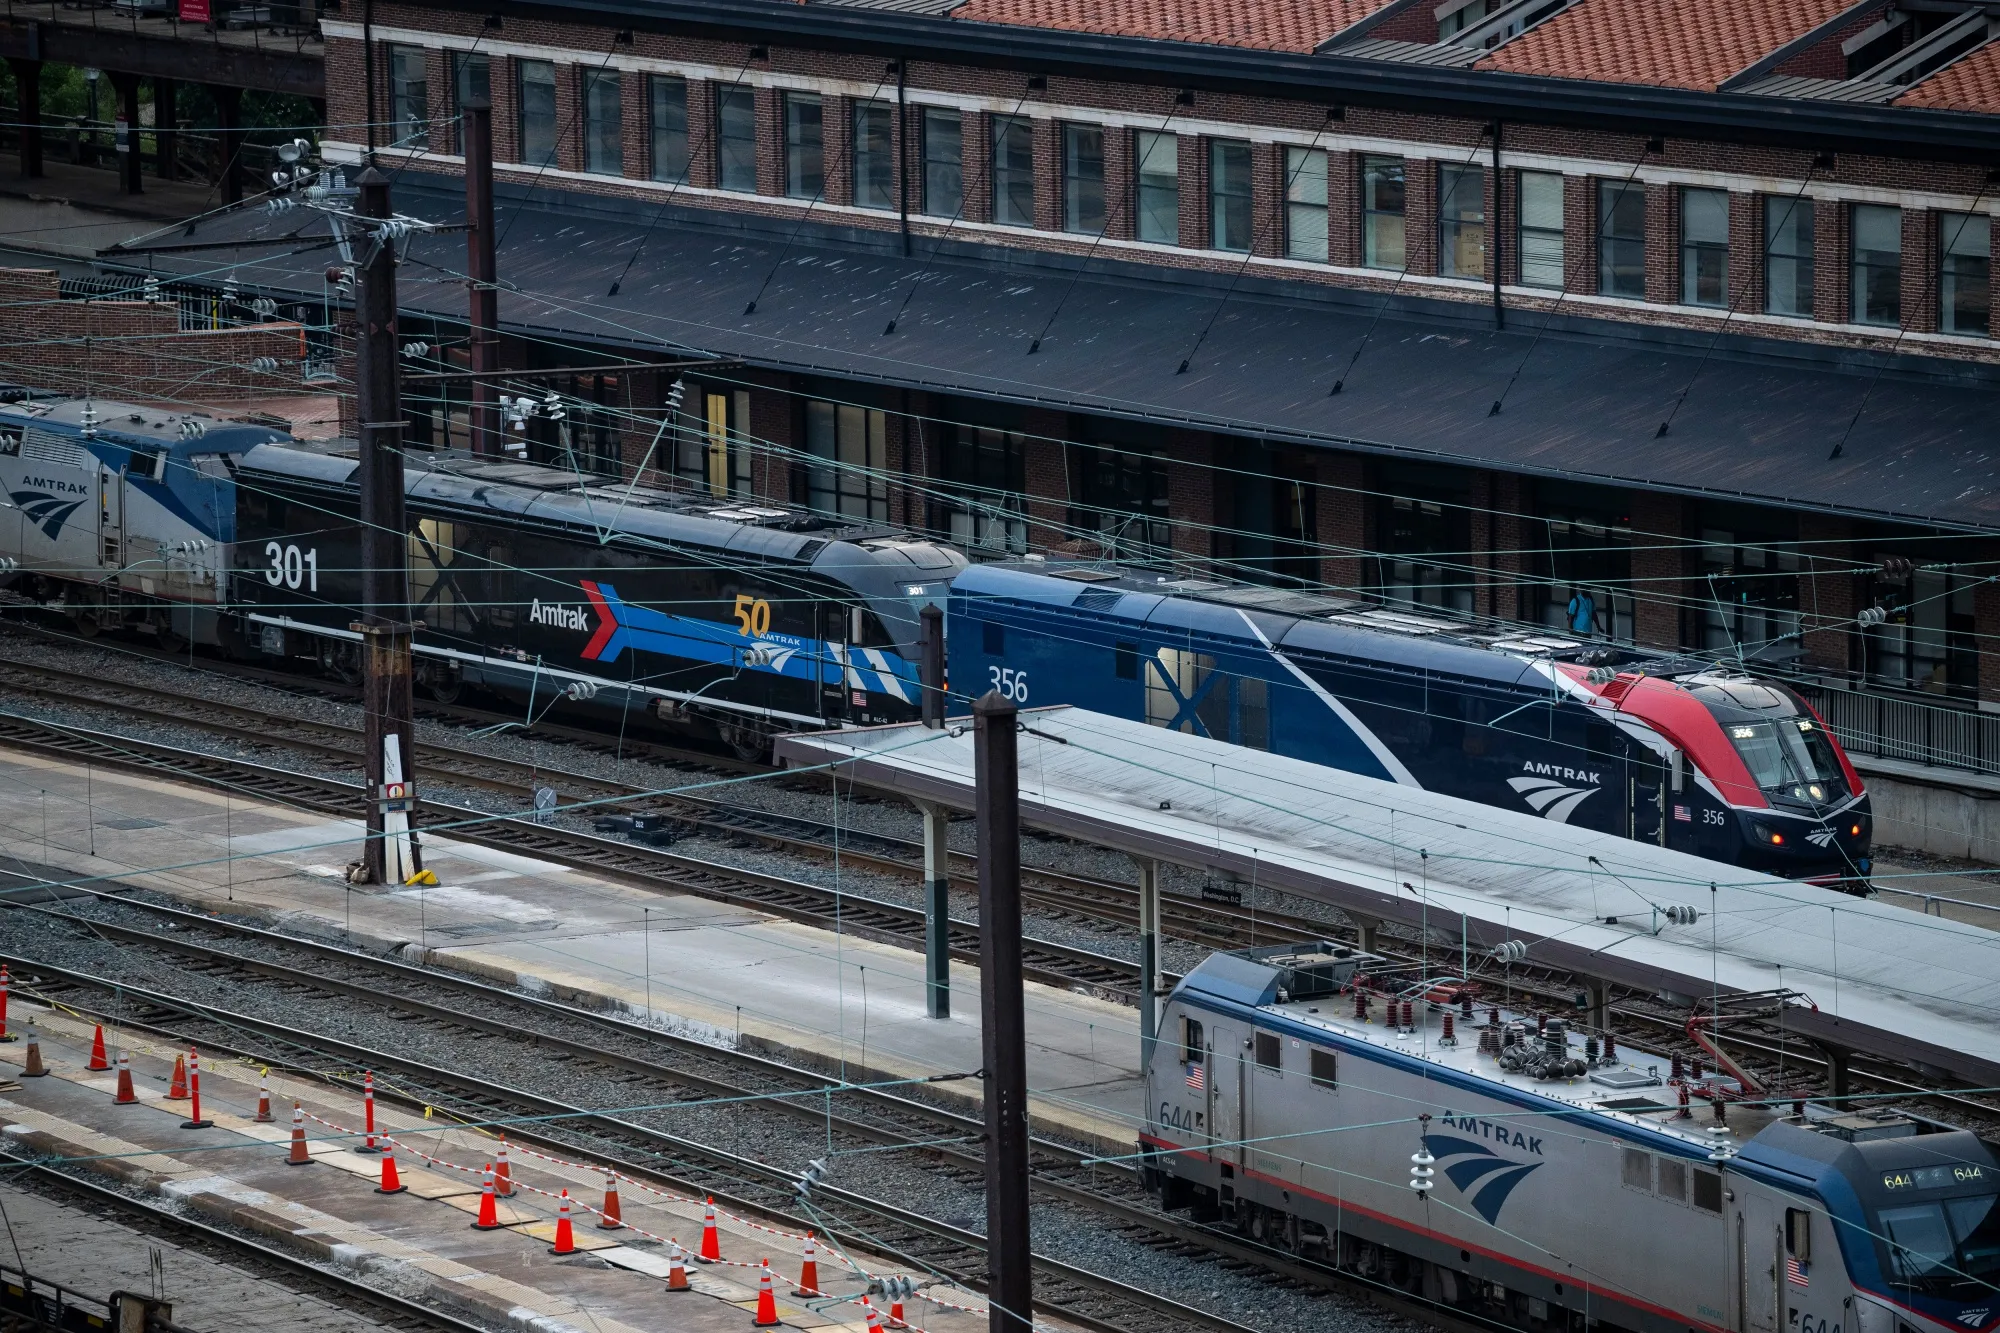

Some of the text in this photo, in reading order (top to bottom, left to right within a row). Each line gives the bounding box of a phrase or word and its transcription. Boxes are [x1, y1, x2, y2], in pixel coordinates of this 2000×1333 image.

[23, 476, 88, 495] AMTRAK
[266, 541, 317, 592] 301
[909, 587, 923, 595] 301
[530, 598, 588, 632] Amtrak
[734, 594, 771, 638] 50
[760, 632, 800, 646] AMTRAK
[989, 665, 1028, 703] 356
[1733, 728, 1754, 739] 356
[1523, 760, 1600, 784] AMTRAK
[1702, 808, 1725, 826] 356
[1160, 1101, 1193, 1139] 644
[1442, 1109, 1543, 1156] AMTRAK
[1884, 1173, 1913, 1189] 644
[1954, 1166, 1983, 1181] 644
